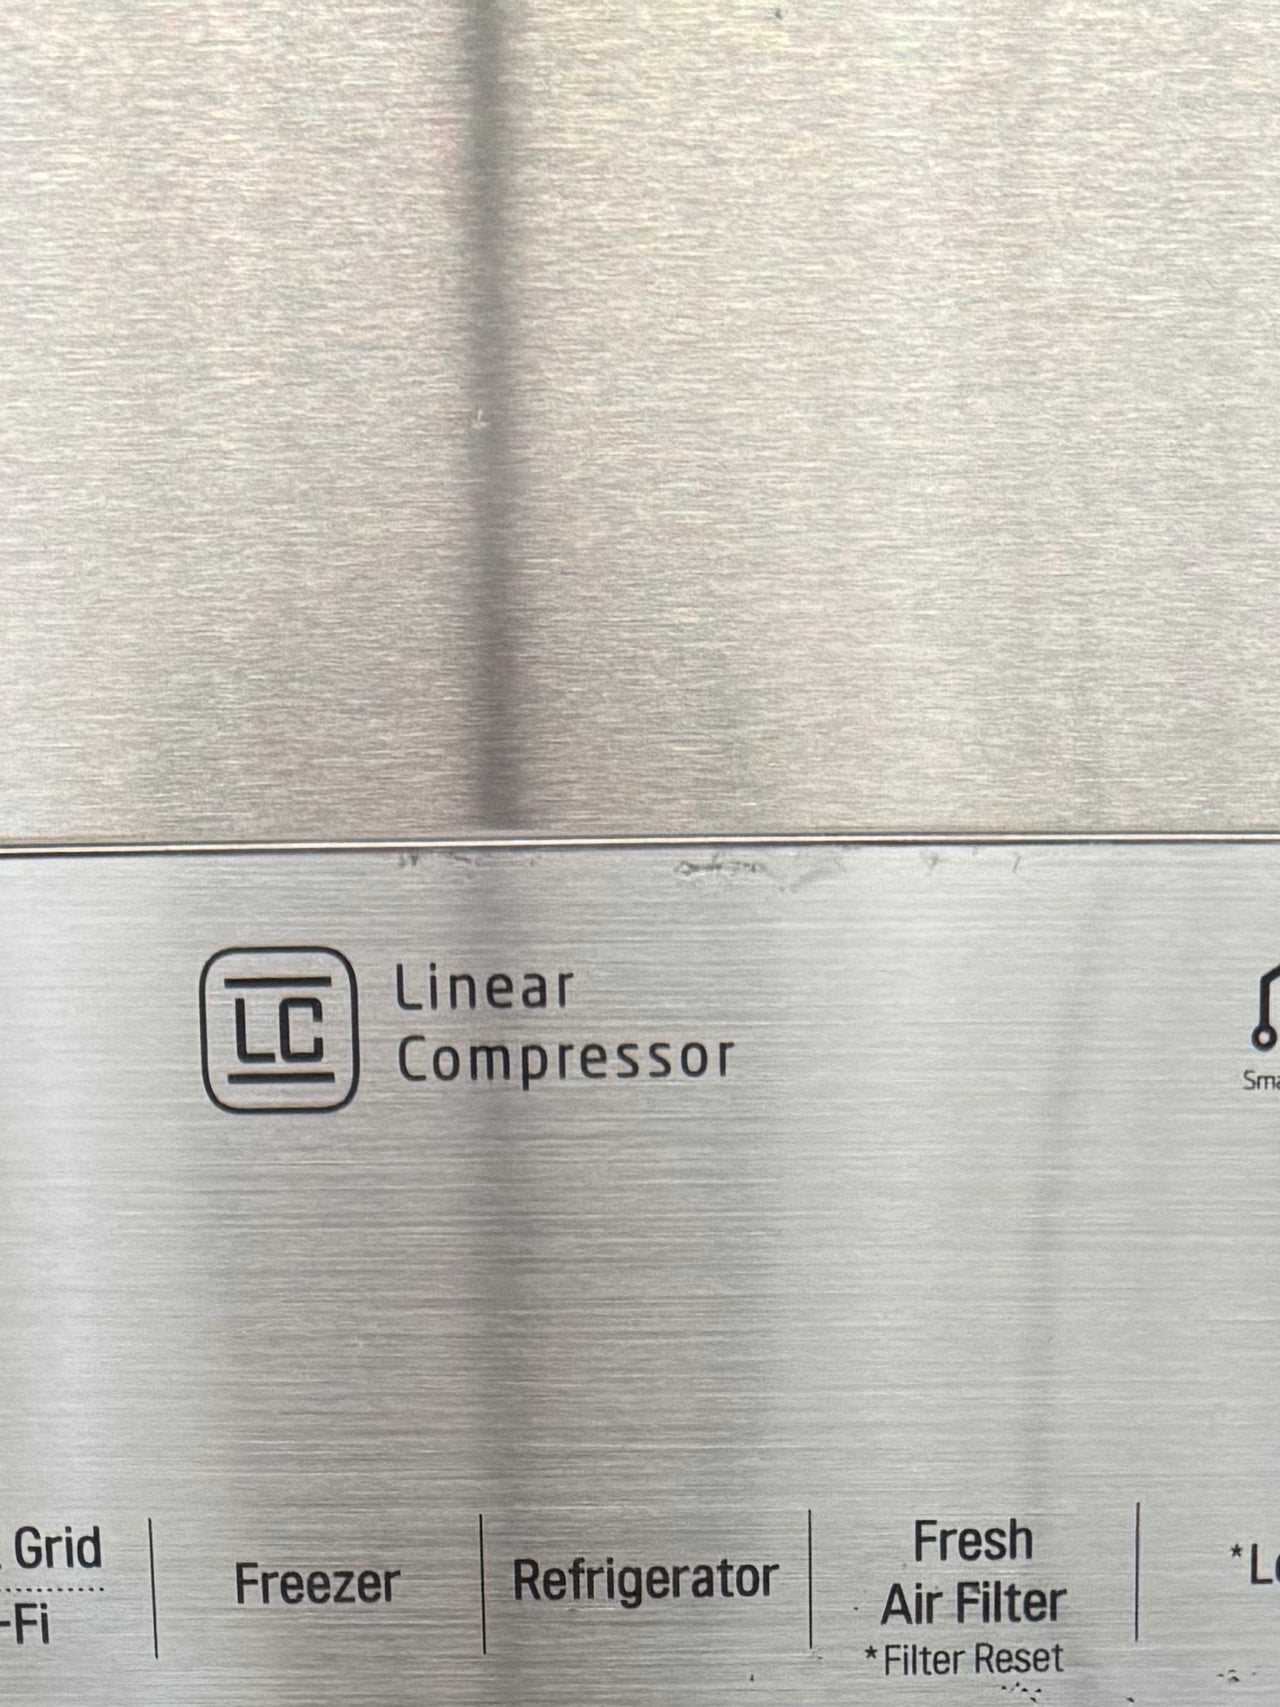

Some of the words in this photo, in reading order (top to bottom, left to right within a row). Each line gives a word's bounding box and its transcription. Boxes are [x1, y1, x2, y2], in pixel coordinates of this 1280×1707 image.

[395, 961, 574, 1011] Linear
[398, 1034, 736, 1092] Compressor
[14, 1525, 102, 1570] Grid
[914, 1517, 1033, 1563] Fresh
[235, 1561, 402, 1605] Freezer
[513, 1556, 781, 1610] Refrigerator
[879, 1582, 944, 1626] Air
[956, 1580, 1068, 1624] Filter
[974, 1641, 1065, 1674] Reset
